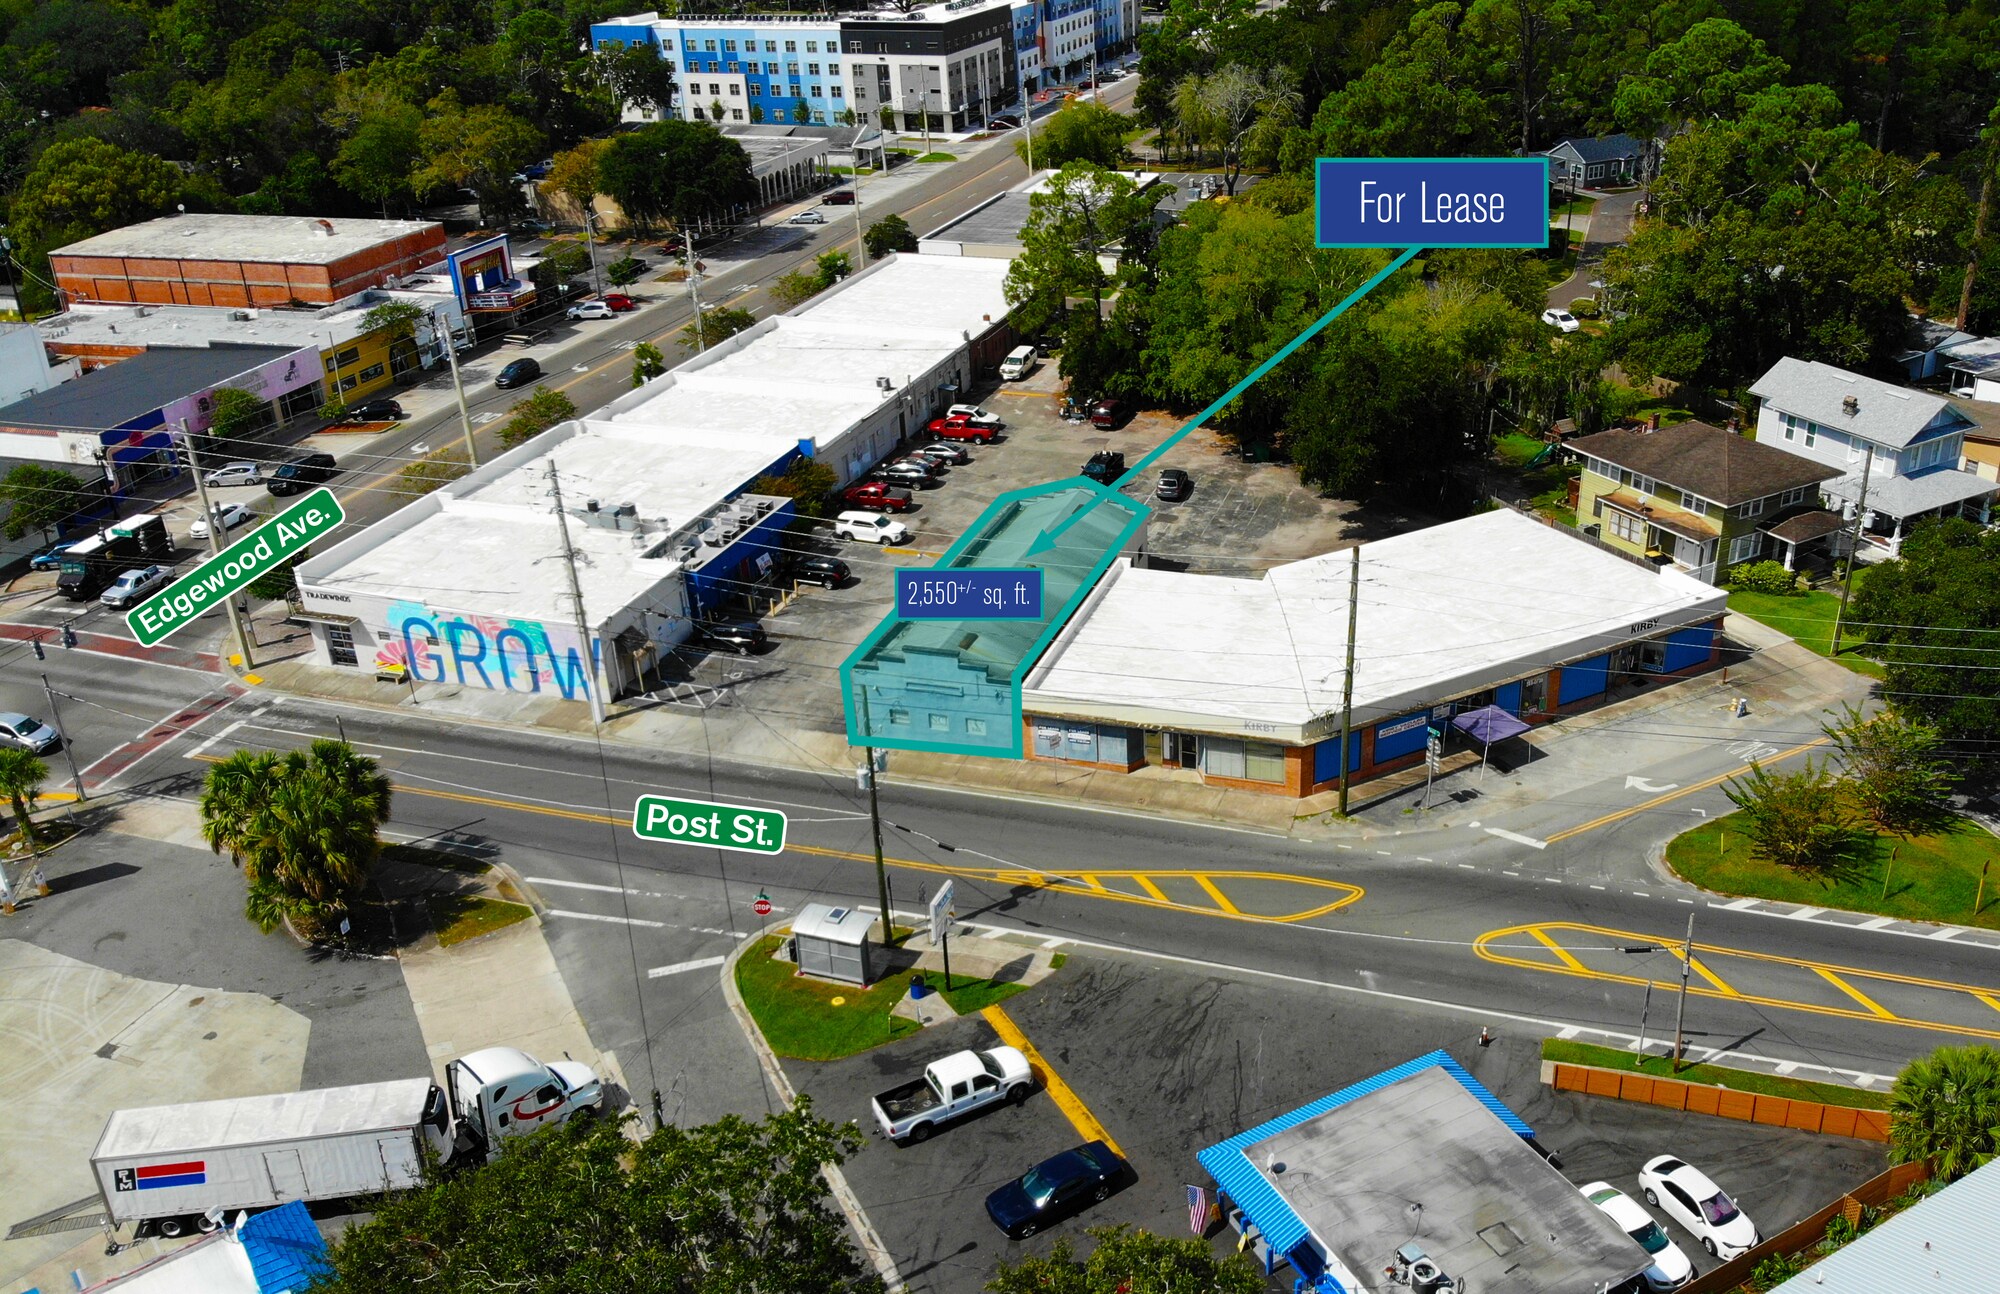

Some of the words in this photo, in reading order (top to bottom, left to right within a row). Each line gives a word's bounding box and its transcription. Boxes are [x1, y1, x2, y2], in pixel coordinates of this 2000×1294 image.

[305, 591, 352, 603] TRADEWINDS
[1630, 618, 1660, 634] KIRBY
[402, 616, 600, 701] GROW
[1244, 720, 1277, 733] KIRBY
